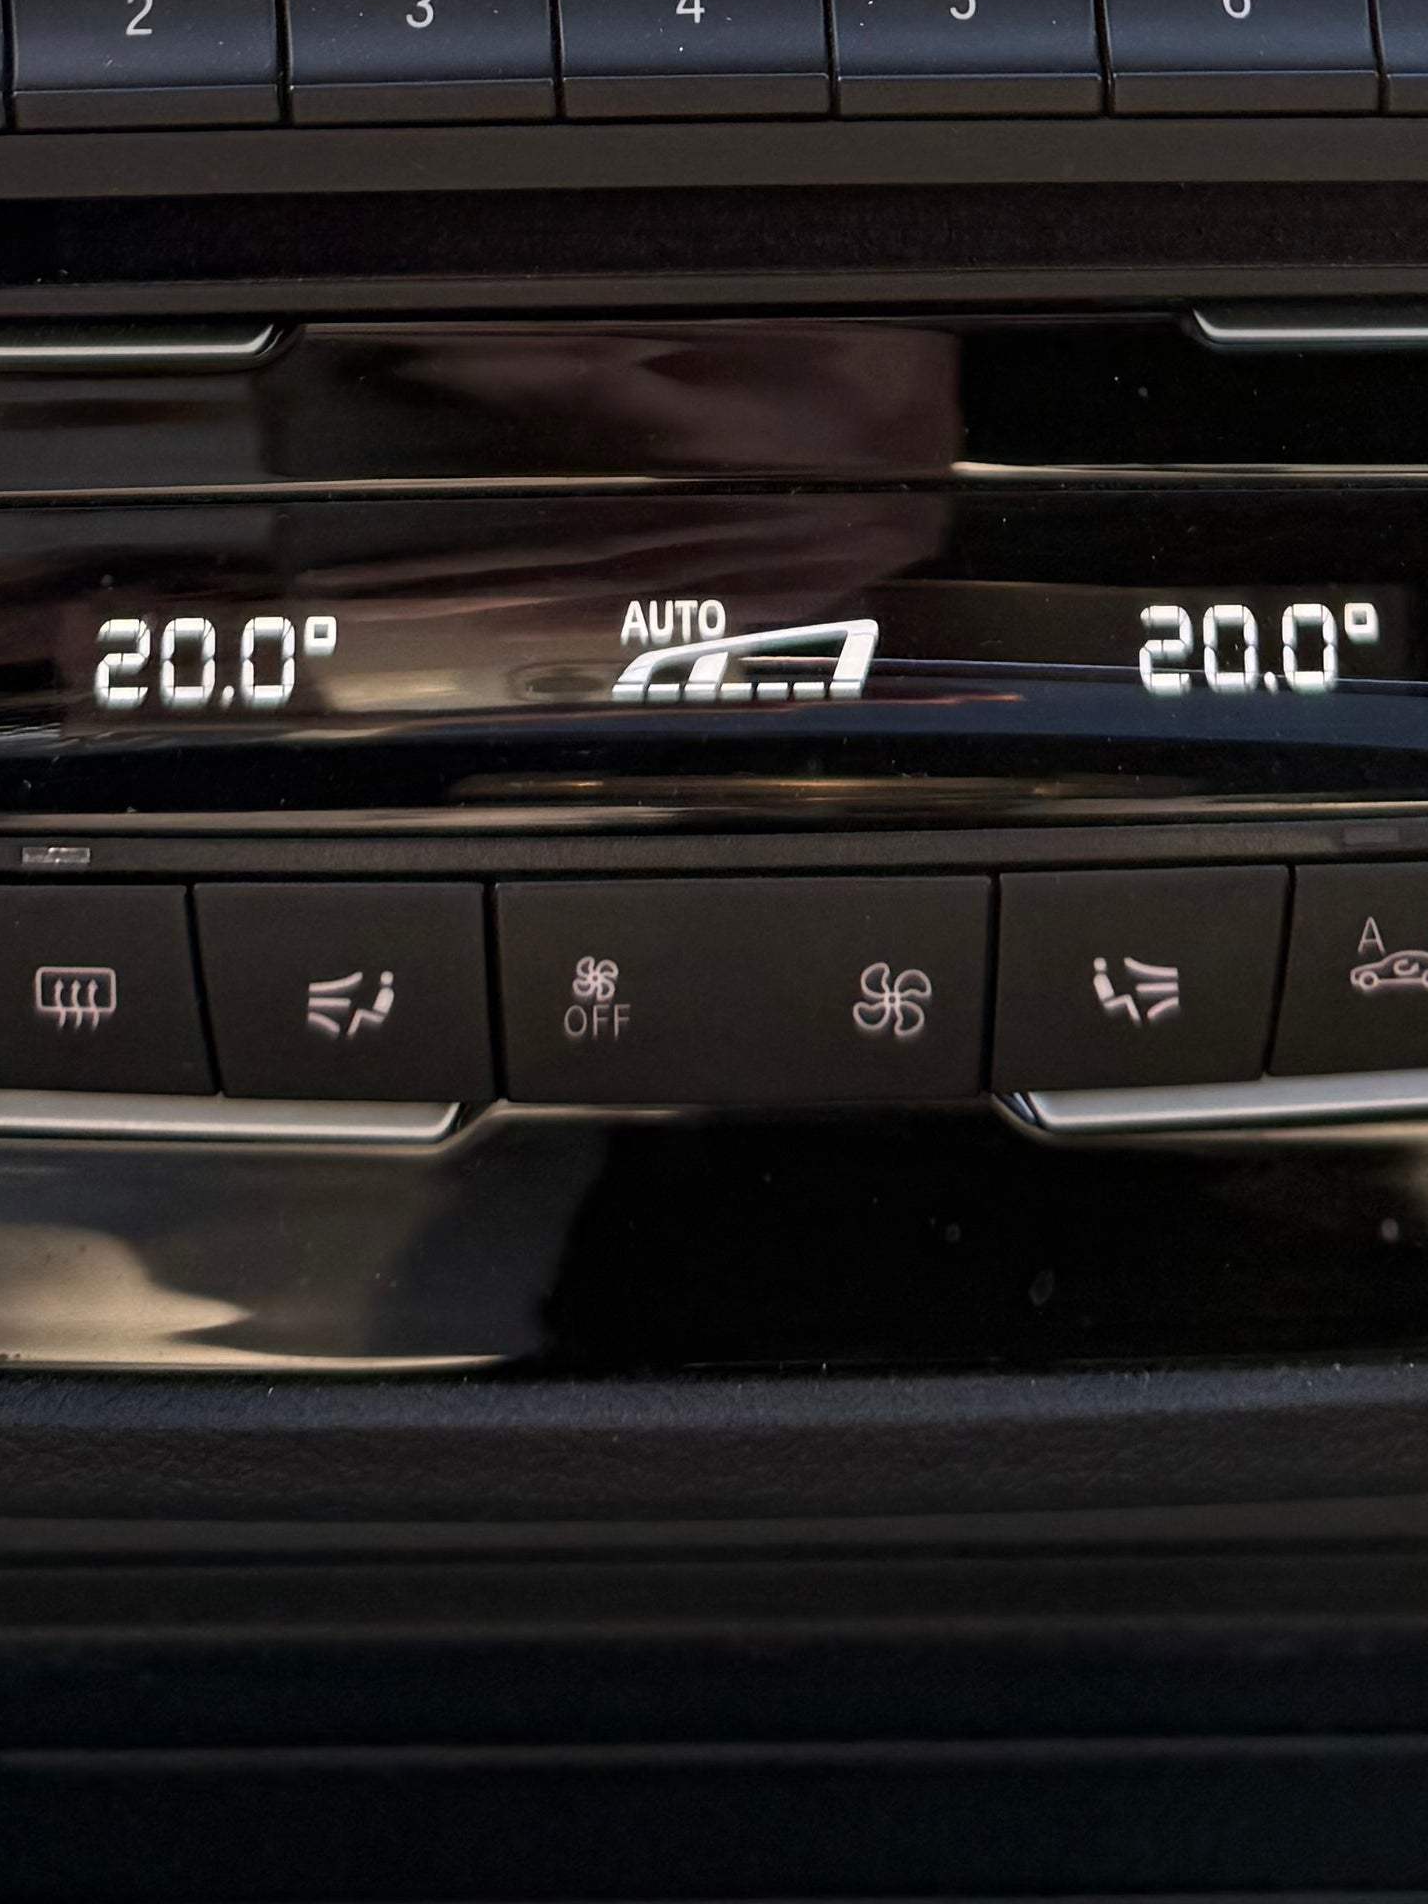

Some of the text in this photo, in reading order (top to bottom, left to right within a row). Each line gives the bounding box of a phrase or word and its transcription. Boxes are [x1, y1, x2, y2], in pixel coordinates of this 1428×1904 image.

[620, 599, 726, 646] AUTO
[1357, 916, 1385, 953] A
[563, 1004, 630, 1039] OFF
